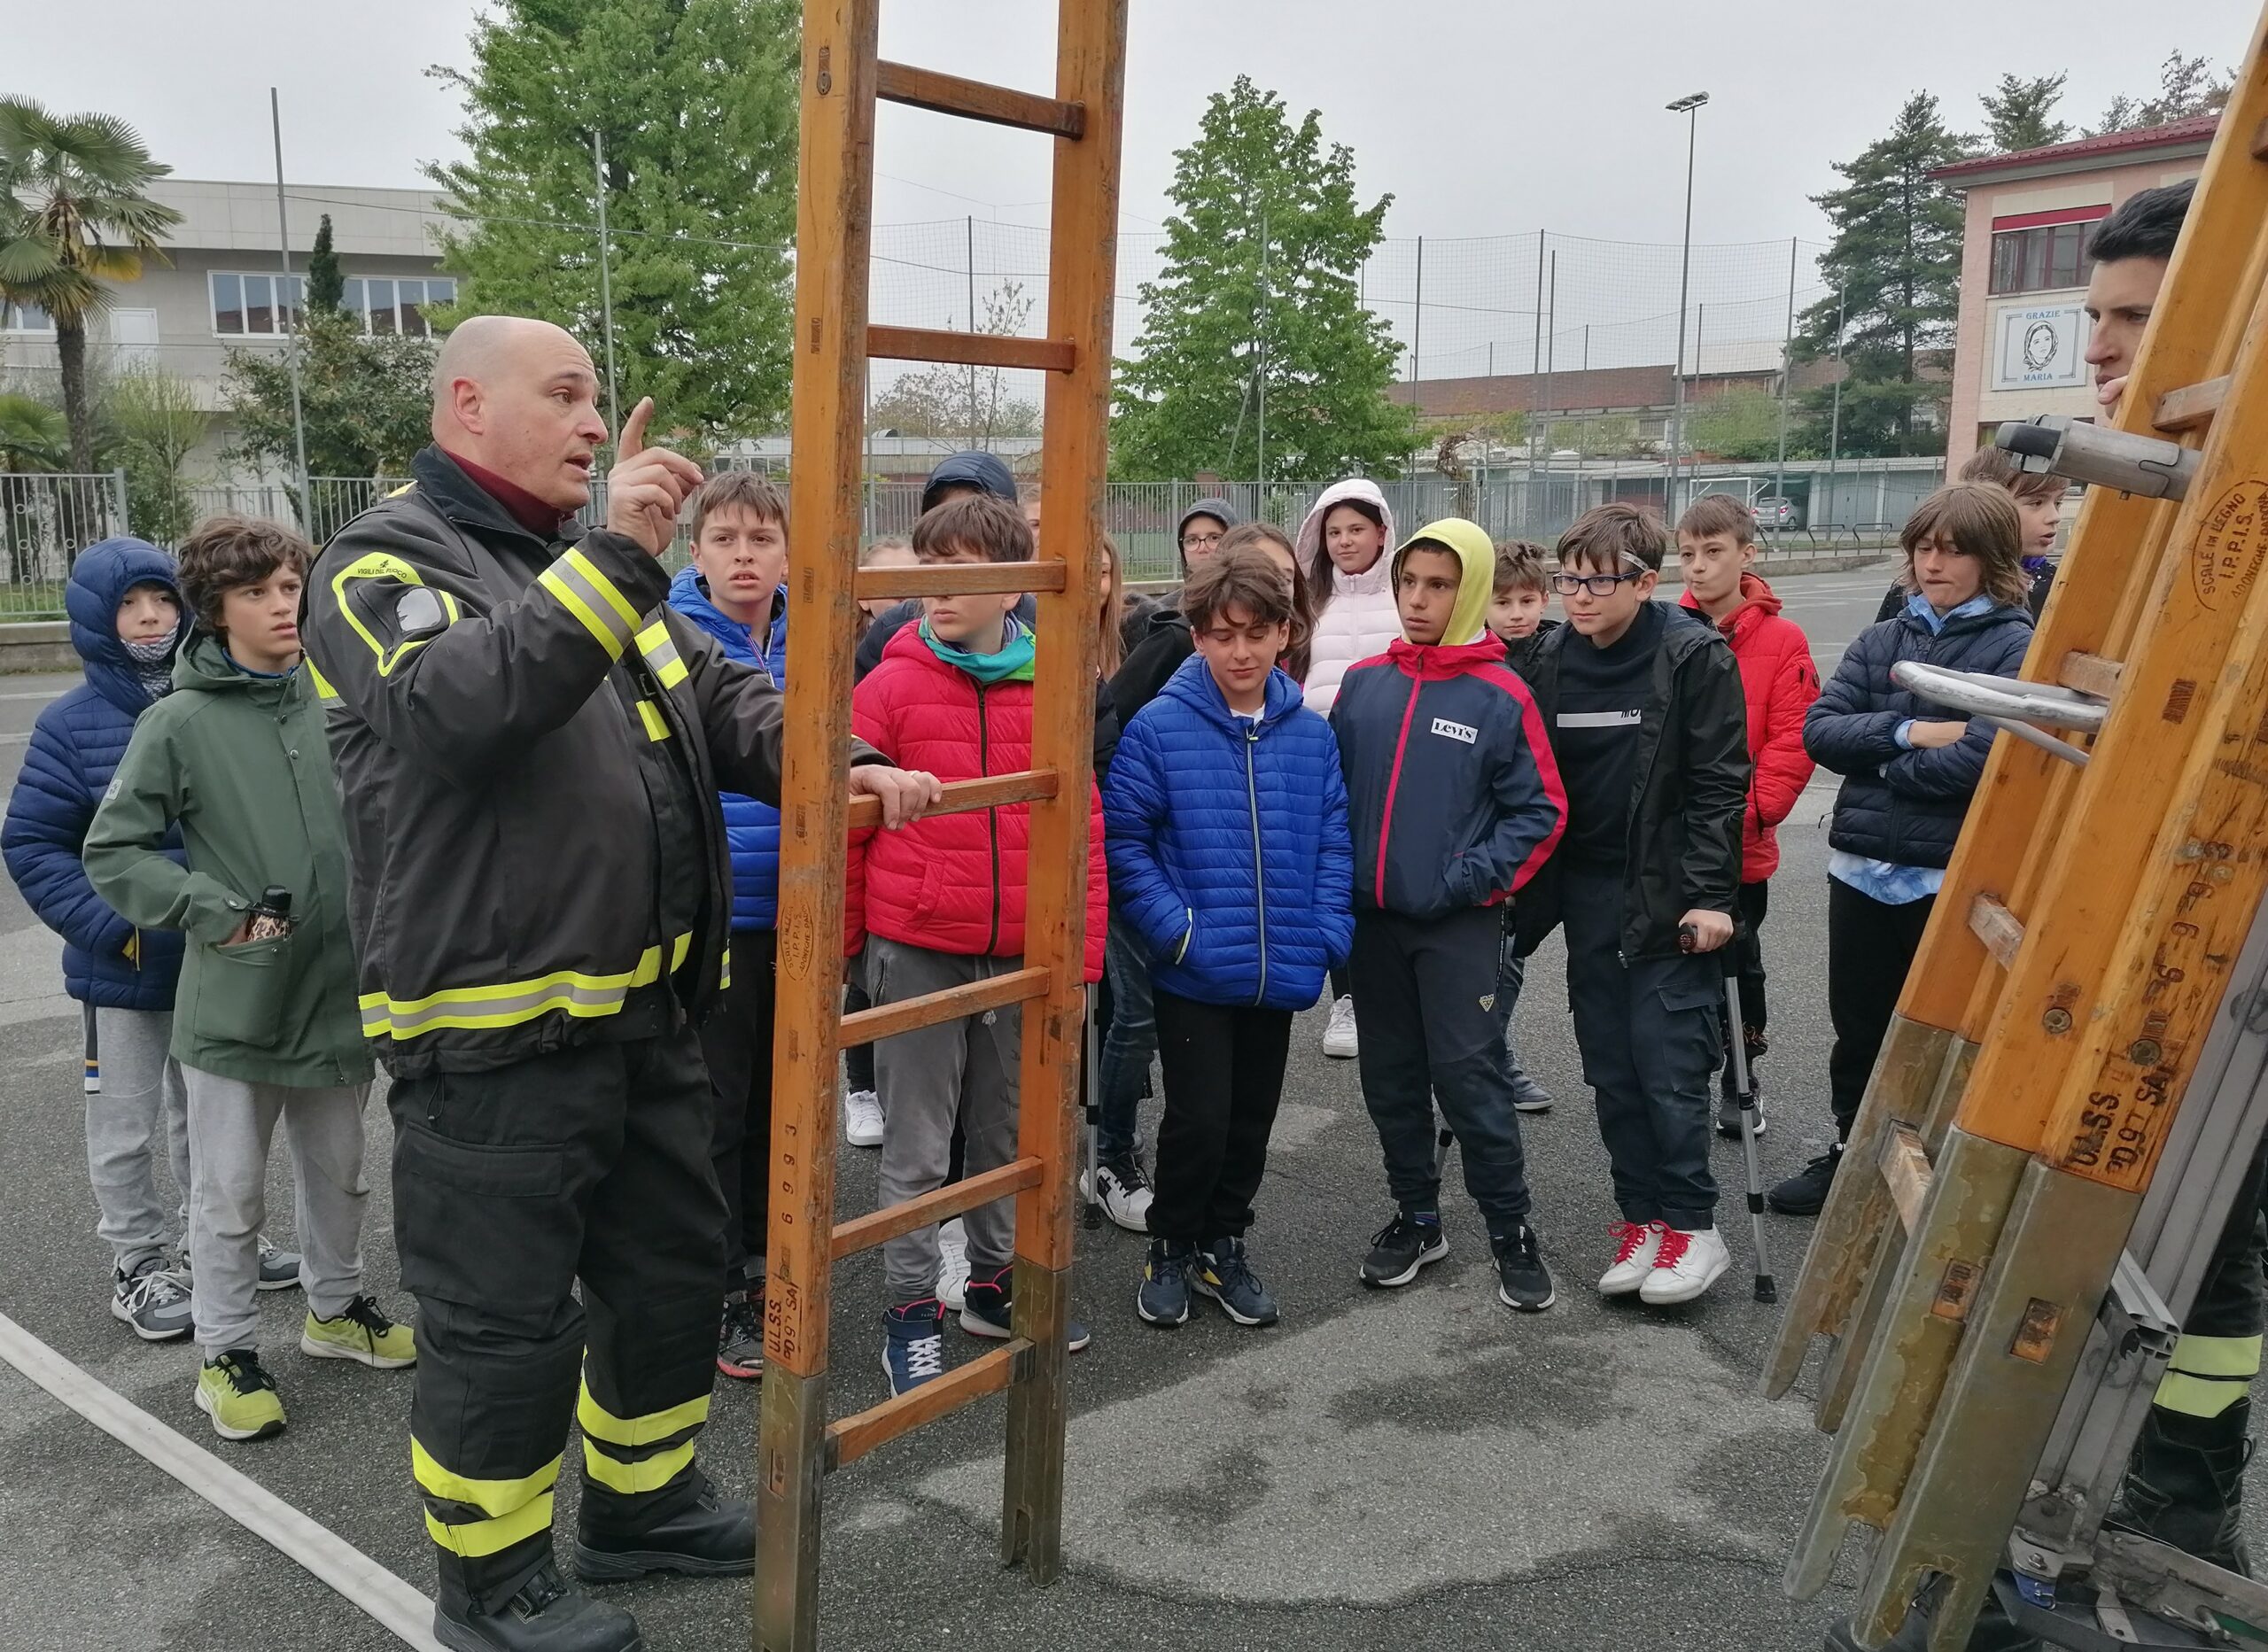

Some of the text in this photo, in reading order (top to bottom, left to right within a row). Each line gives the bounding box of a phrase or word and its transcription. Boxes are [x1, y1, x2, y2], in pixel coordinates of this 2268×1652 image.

[2025, 310, 2061, 320] GRAZIE
[2023, 373, 2053, 382] MARIA
[2201, 552, 2216, 595] SCALE
[2211, 492, 2246, 532] LEGNO
[386, 568, 408, 578] FUOCO
